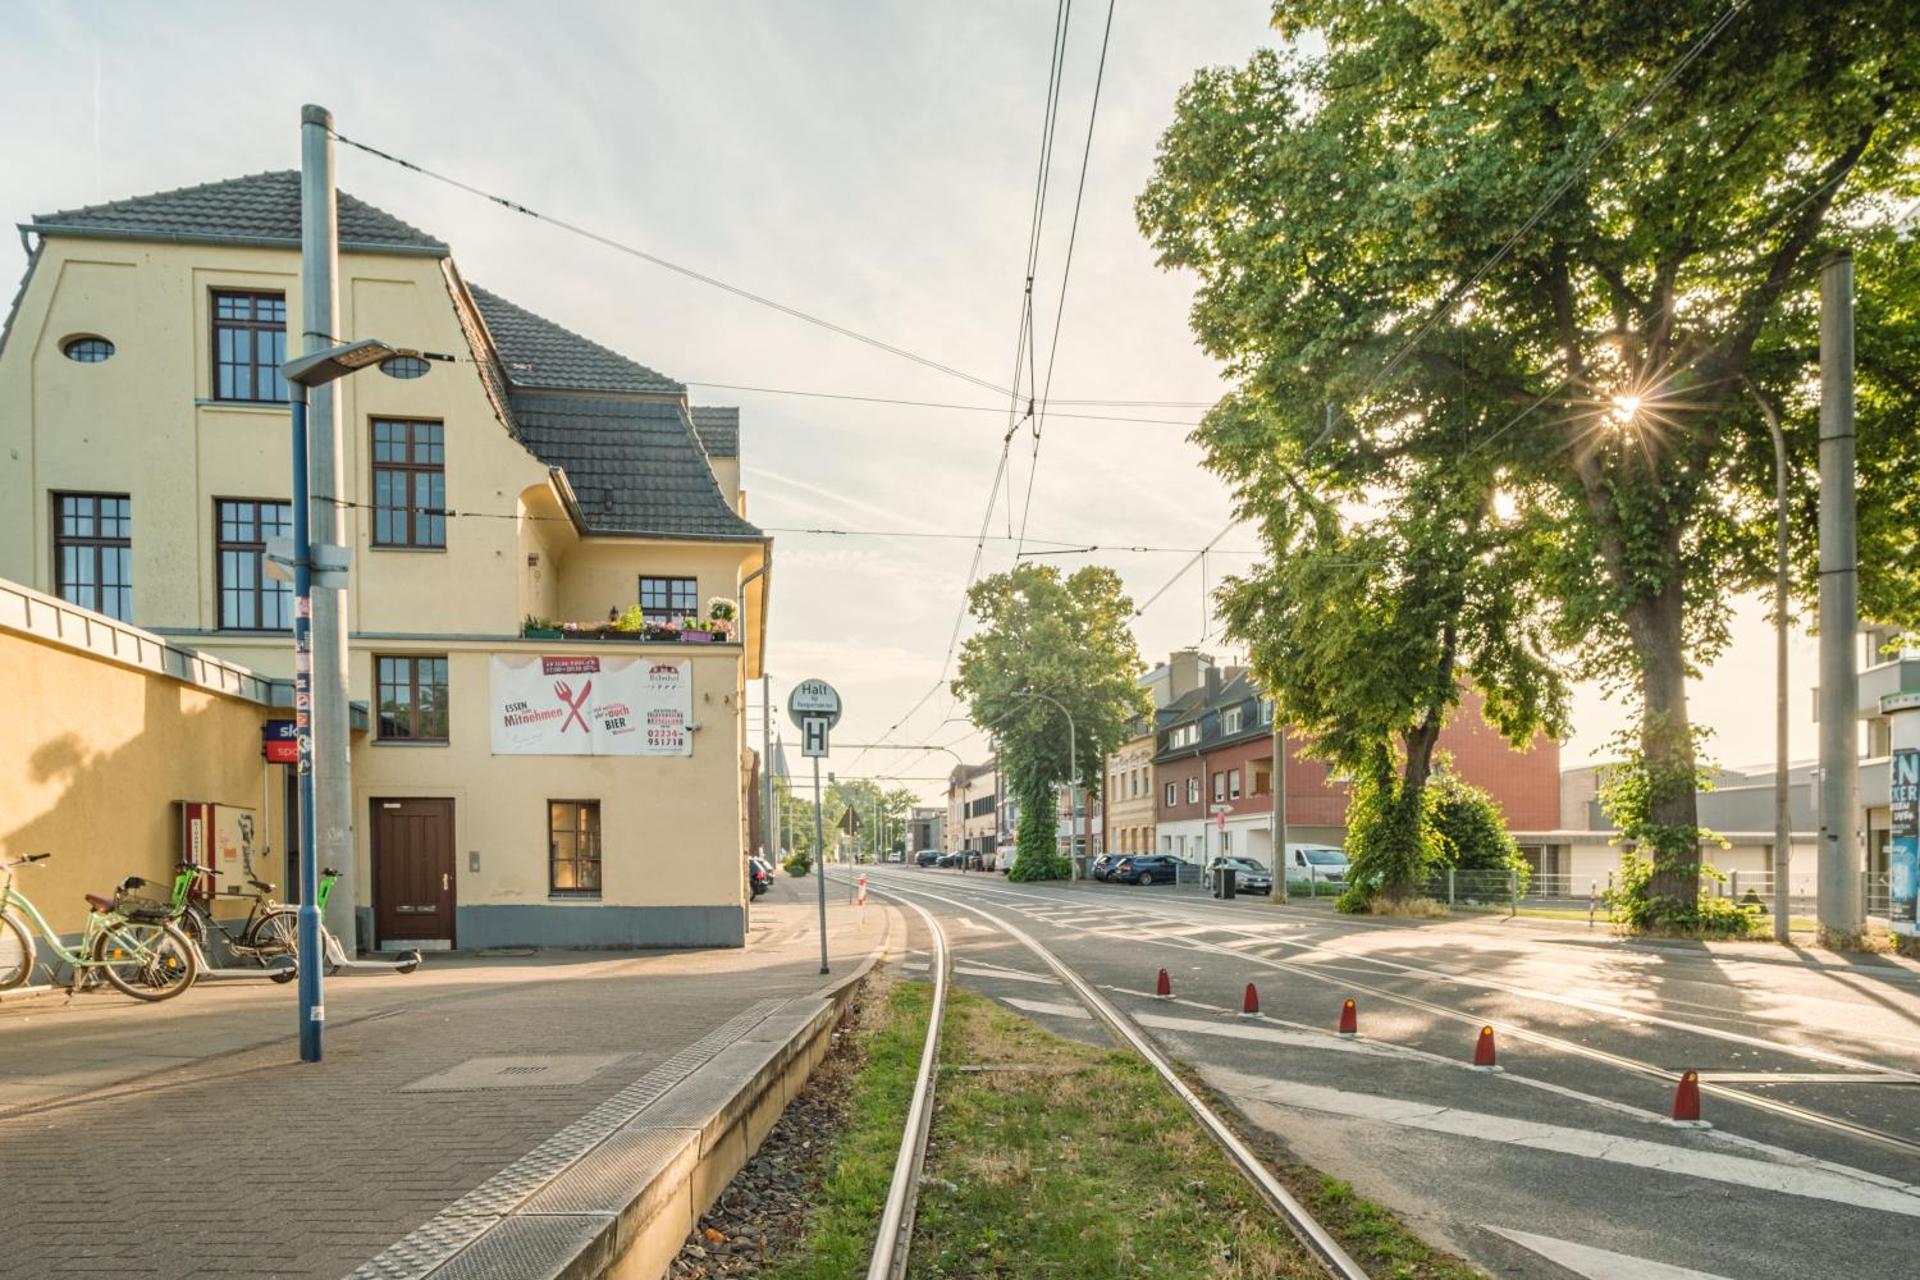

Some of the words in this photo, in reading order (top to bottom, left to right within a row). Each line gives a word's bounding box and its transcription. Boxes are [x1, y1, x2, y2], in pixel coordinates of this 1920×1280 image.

[802, 683, 827, 695] Halt
[505, 701, 528, 713] ESSEN
[504, 708, 563, 728] Mitnehmen
[605, 718, 626, 731] BIER
[280, 724, 298, 737] sk
[807, 722, 824, 750] H
[648, 738, 684, 747] 951718
